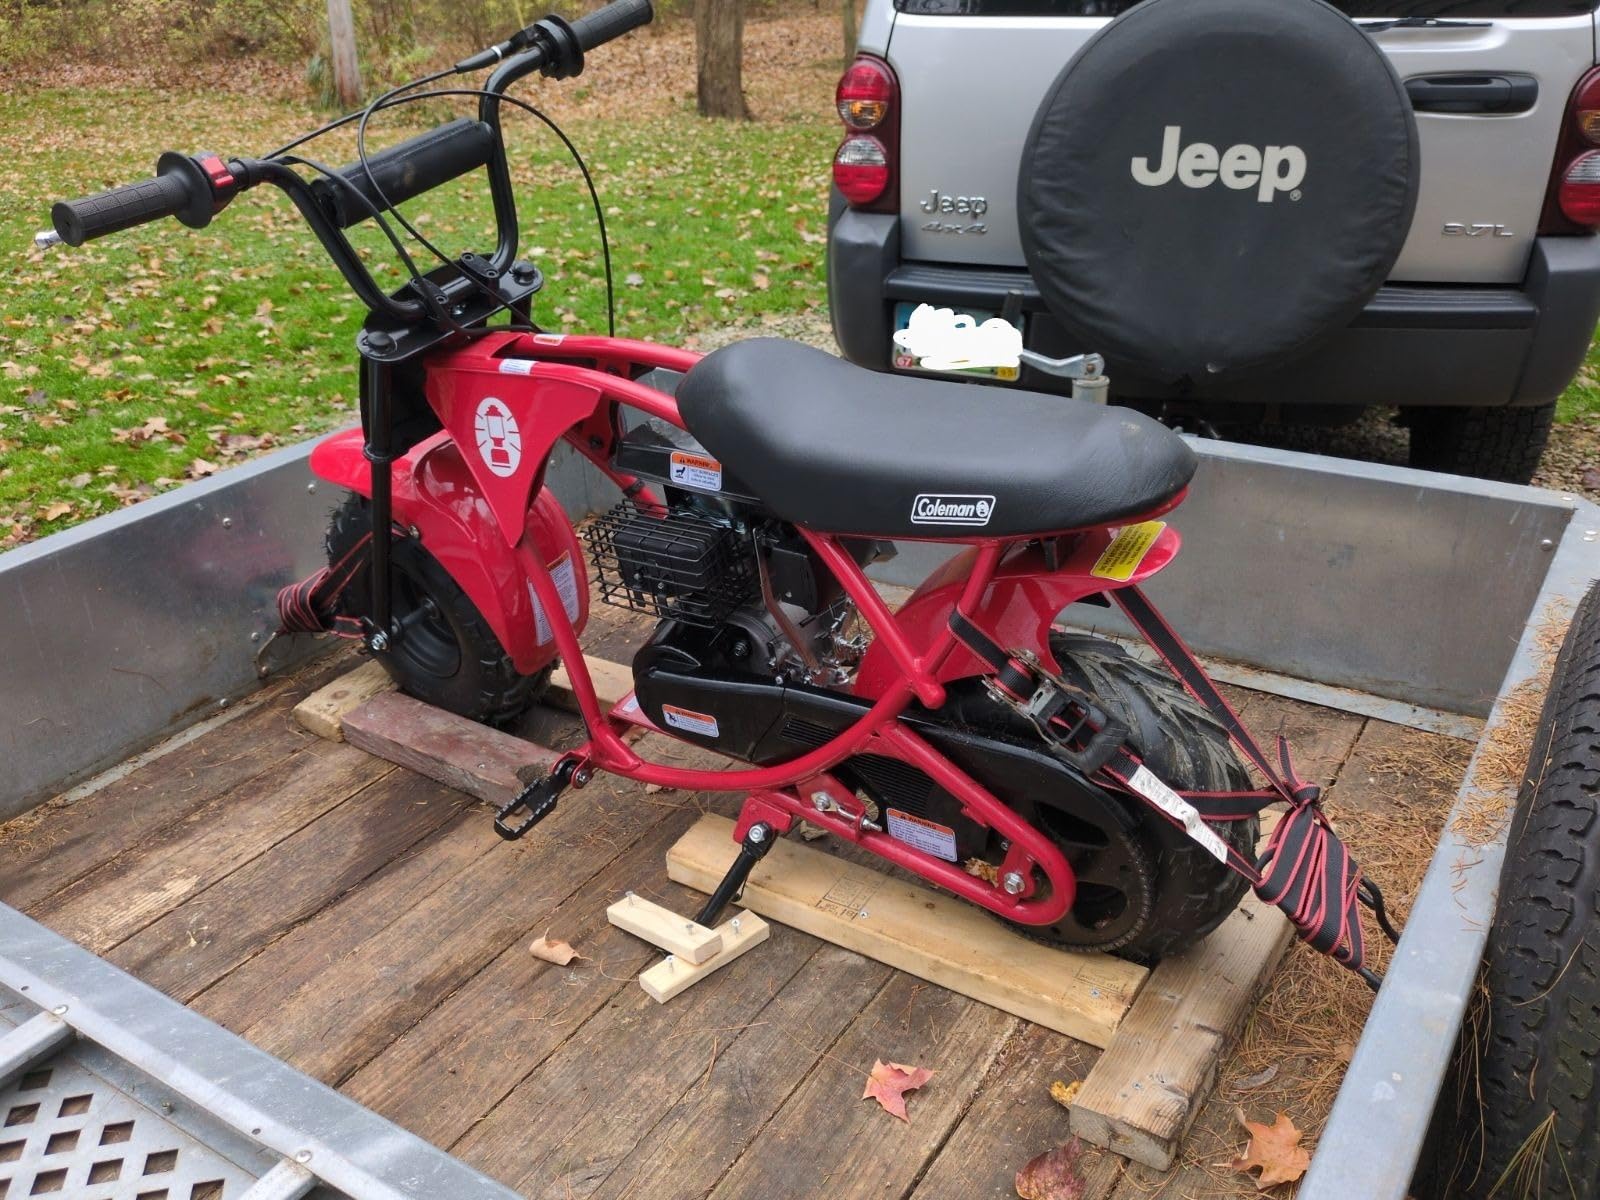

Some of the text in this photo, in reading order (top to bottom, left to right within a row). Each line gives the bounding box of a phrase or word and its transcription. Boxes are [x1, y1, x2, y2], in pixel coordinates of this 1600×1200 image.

[1131, 125, 1307, 203] Jeep
[920, 189, 988, 219] Jeep
[917, 498, 975, 517] Coleman
